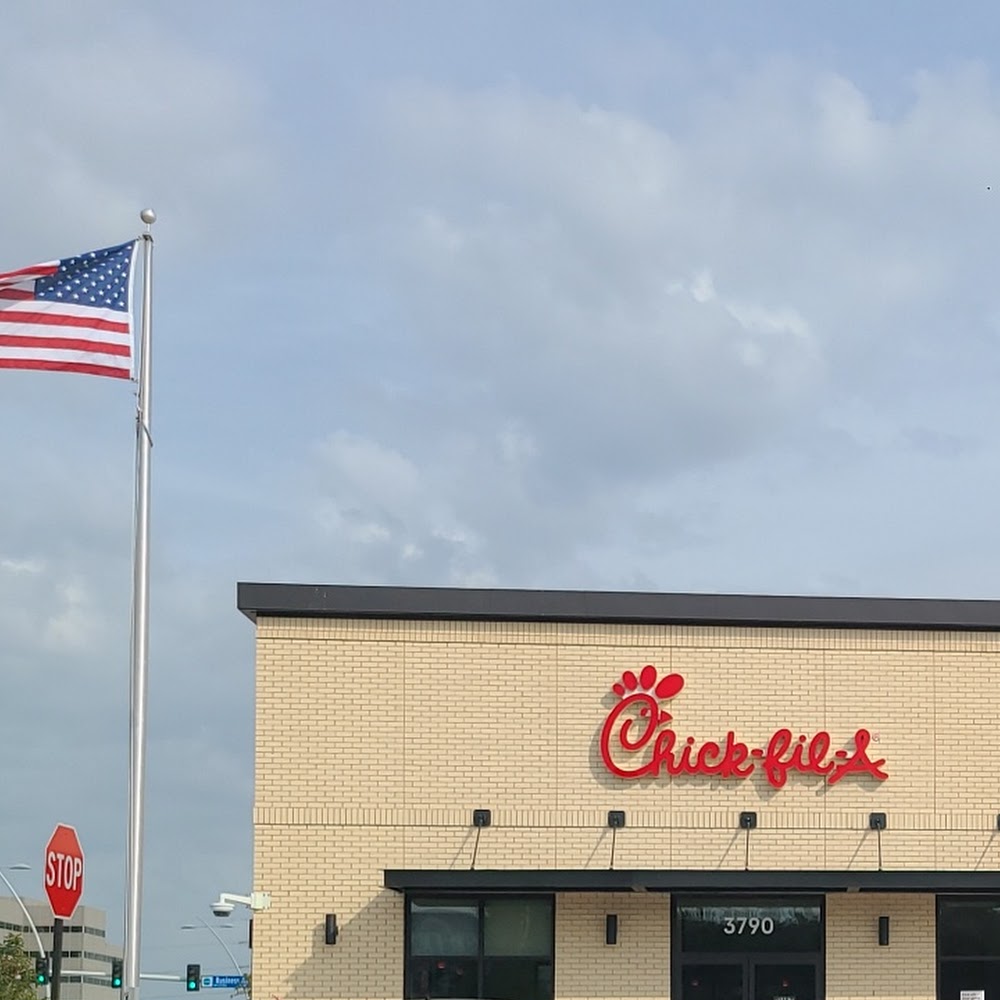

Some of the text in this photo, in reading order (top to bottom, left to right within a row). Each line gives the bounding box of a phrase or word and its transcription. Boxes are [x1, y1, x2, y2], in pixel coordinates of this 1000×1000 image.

[600, 690, 889, 789] Chick-fil-A
[46, 851, 82, 891] STOP
[723, 917, 774, 935] 3790
